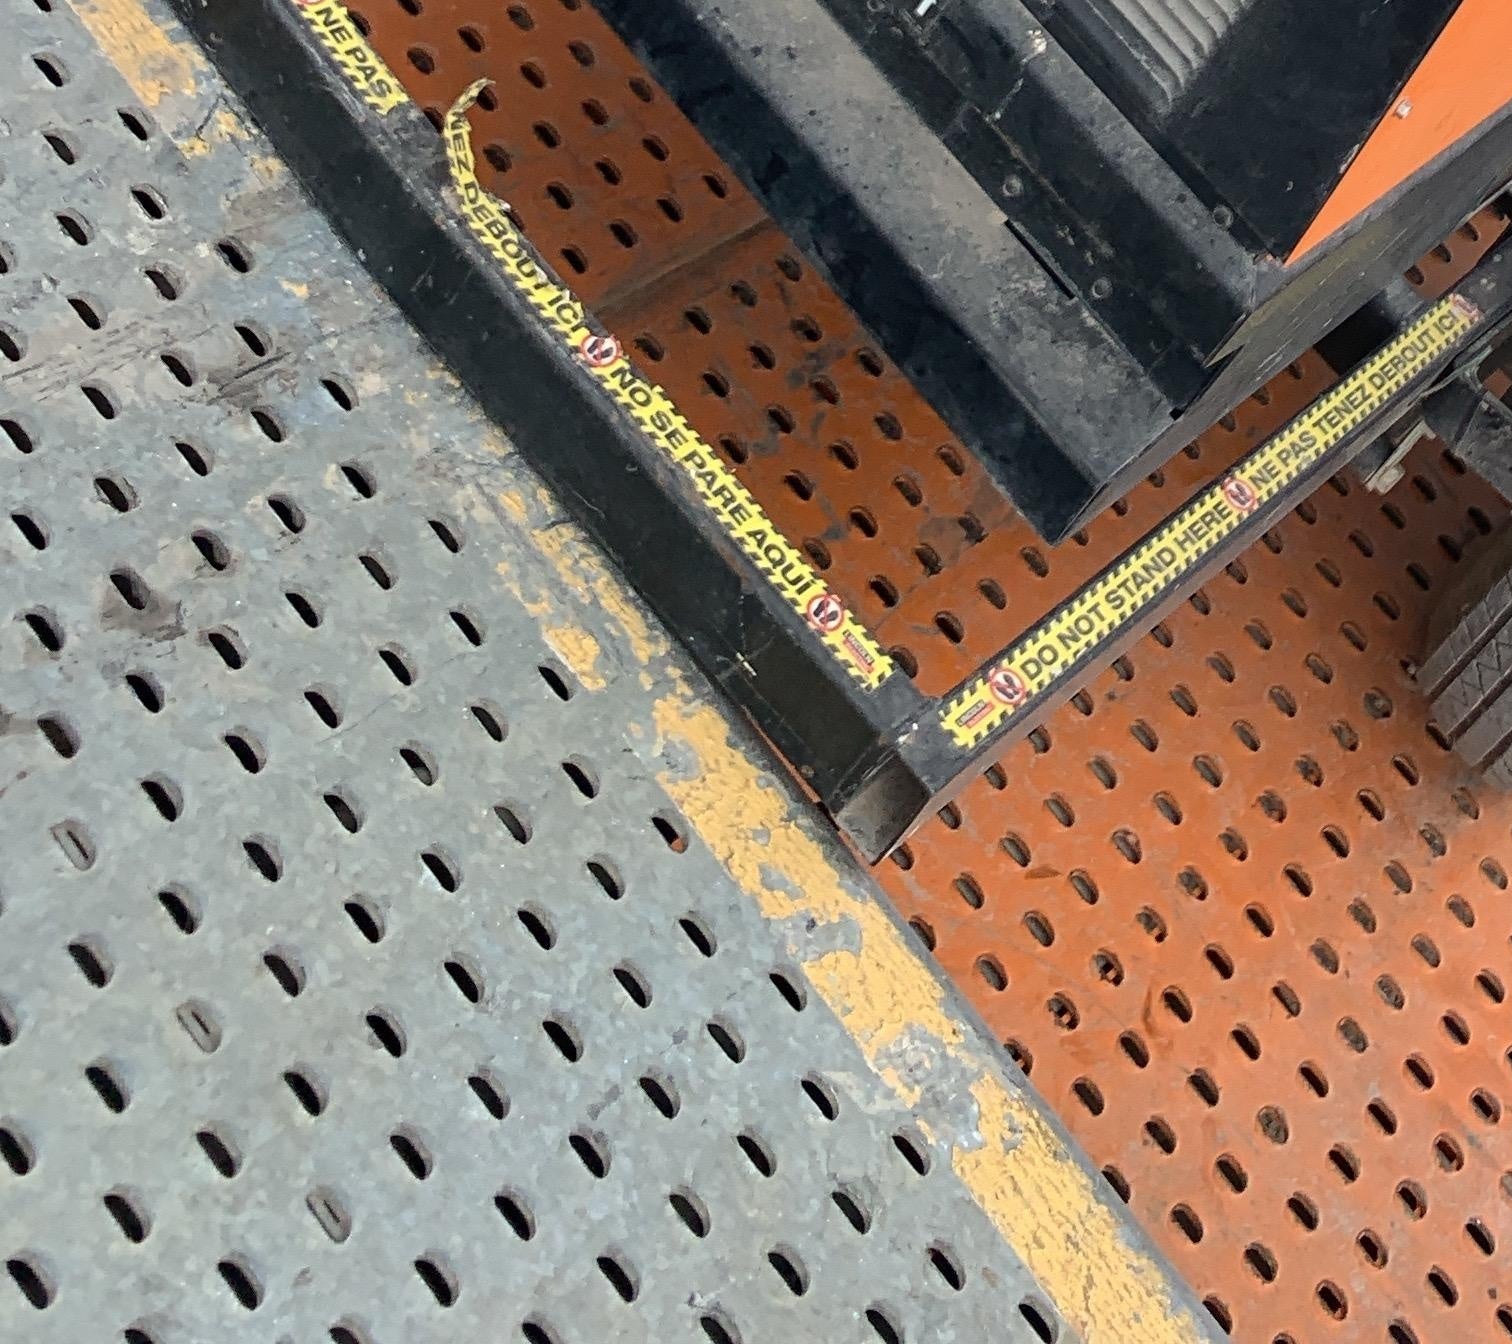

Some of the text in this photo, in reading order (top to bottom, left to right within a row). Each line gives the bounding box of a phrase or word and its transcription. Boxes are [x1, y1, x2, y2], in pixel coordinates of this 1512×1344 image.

[315, 6, 393, 98] NE PAS
[611, 366, 653, 407] NO
[650, 410, 689, 451] SE
[685, 453, 753, 526] PARE
[1249, 466, 1282, 489] NE
[1276, 430, 1319, 462] PAS
[1312, 383, 1373, 437] TENEZ
[1368, 330, 1436, 389] DEBOUT
[1020, 502, 1231, 681] DO NOT STAND HERE
